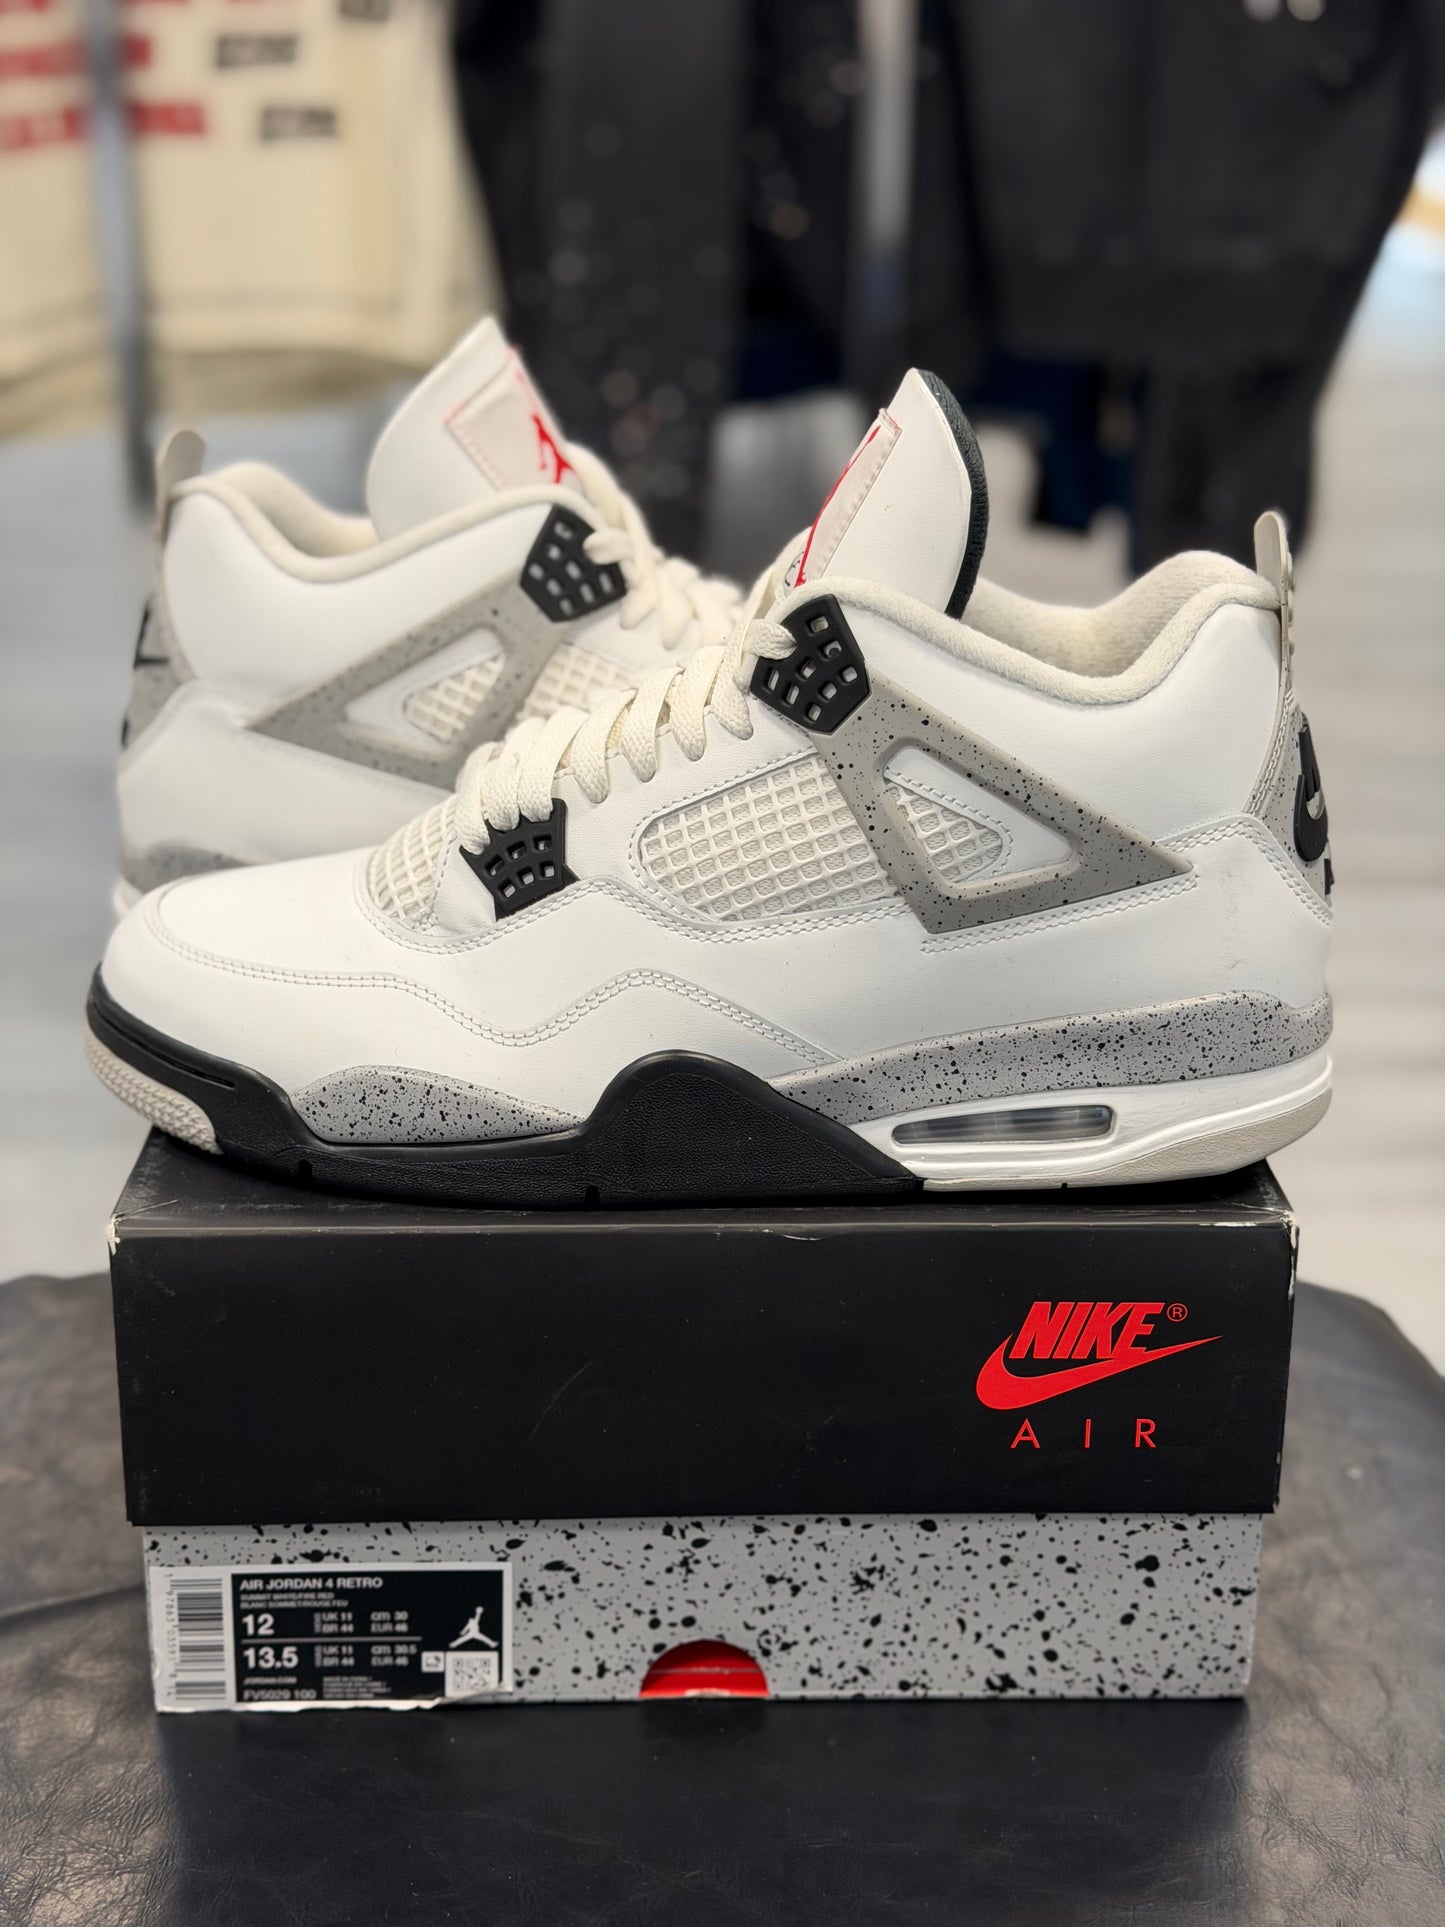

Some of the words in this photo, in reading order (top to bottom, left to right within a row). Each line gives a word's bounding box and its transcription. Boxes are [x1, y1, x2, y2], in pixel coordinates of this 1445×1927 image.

[1010, 1418, 1158, 1450] AIR
[240, 1579, 263, 1590] AIR
[266, 1578, 323, 1590] JORDAN
[325, 1578, 334, 1589] 4
[337, 1577, 384, 1589] RETRO
[242, 1613, 275, 1636] 12
[340, 1612, 353, 1622] 11
[243, 1645, 299, 1669] 13.5
[243, 1689, 291, 1700] FV5029
[293, 1688, 317, 1699] 100
